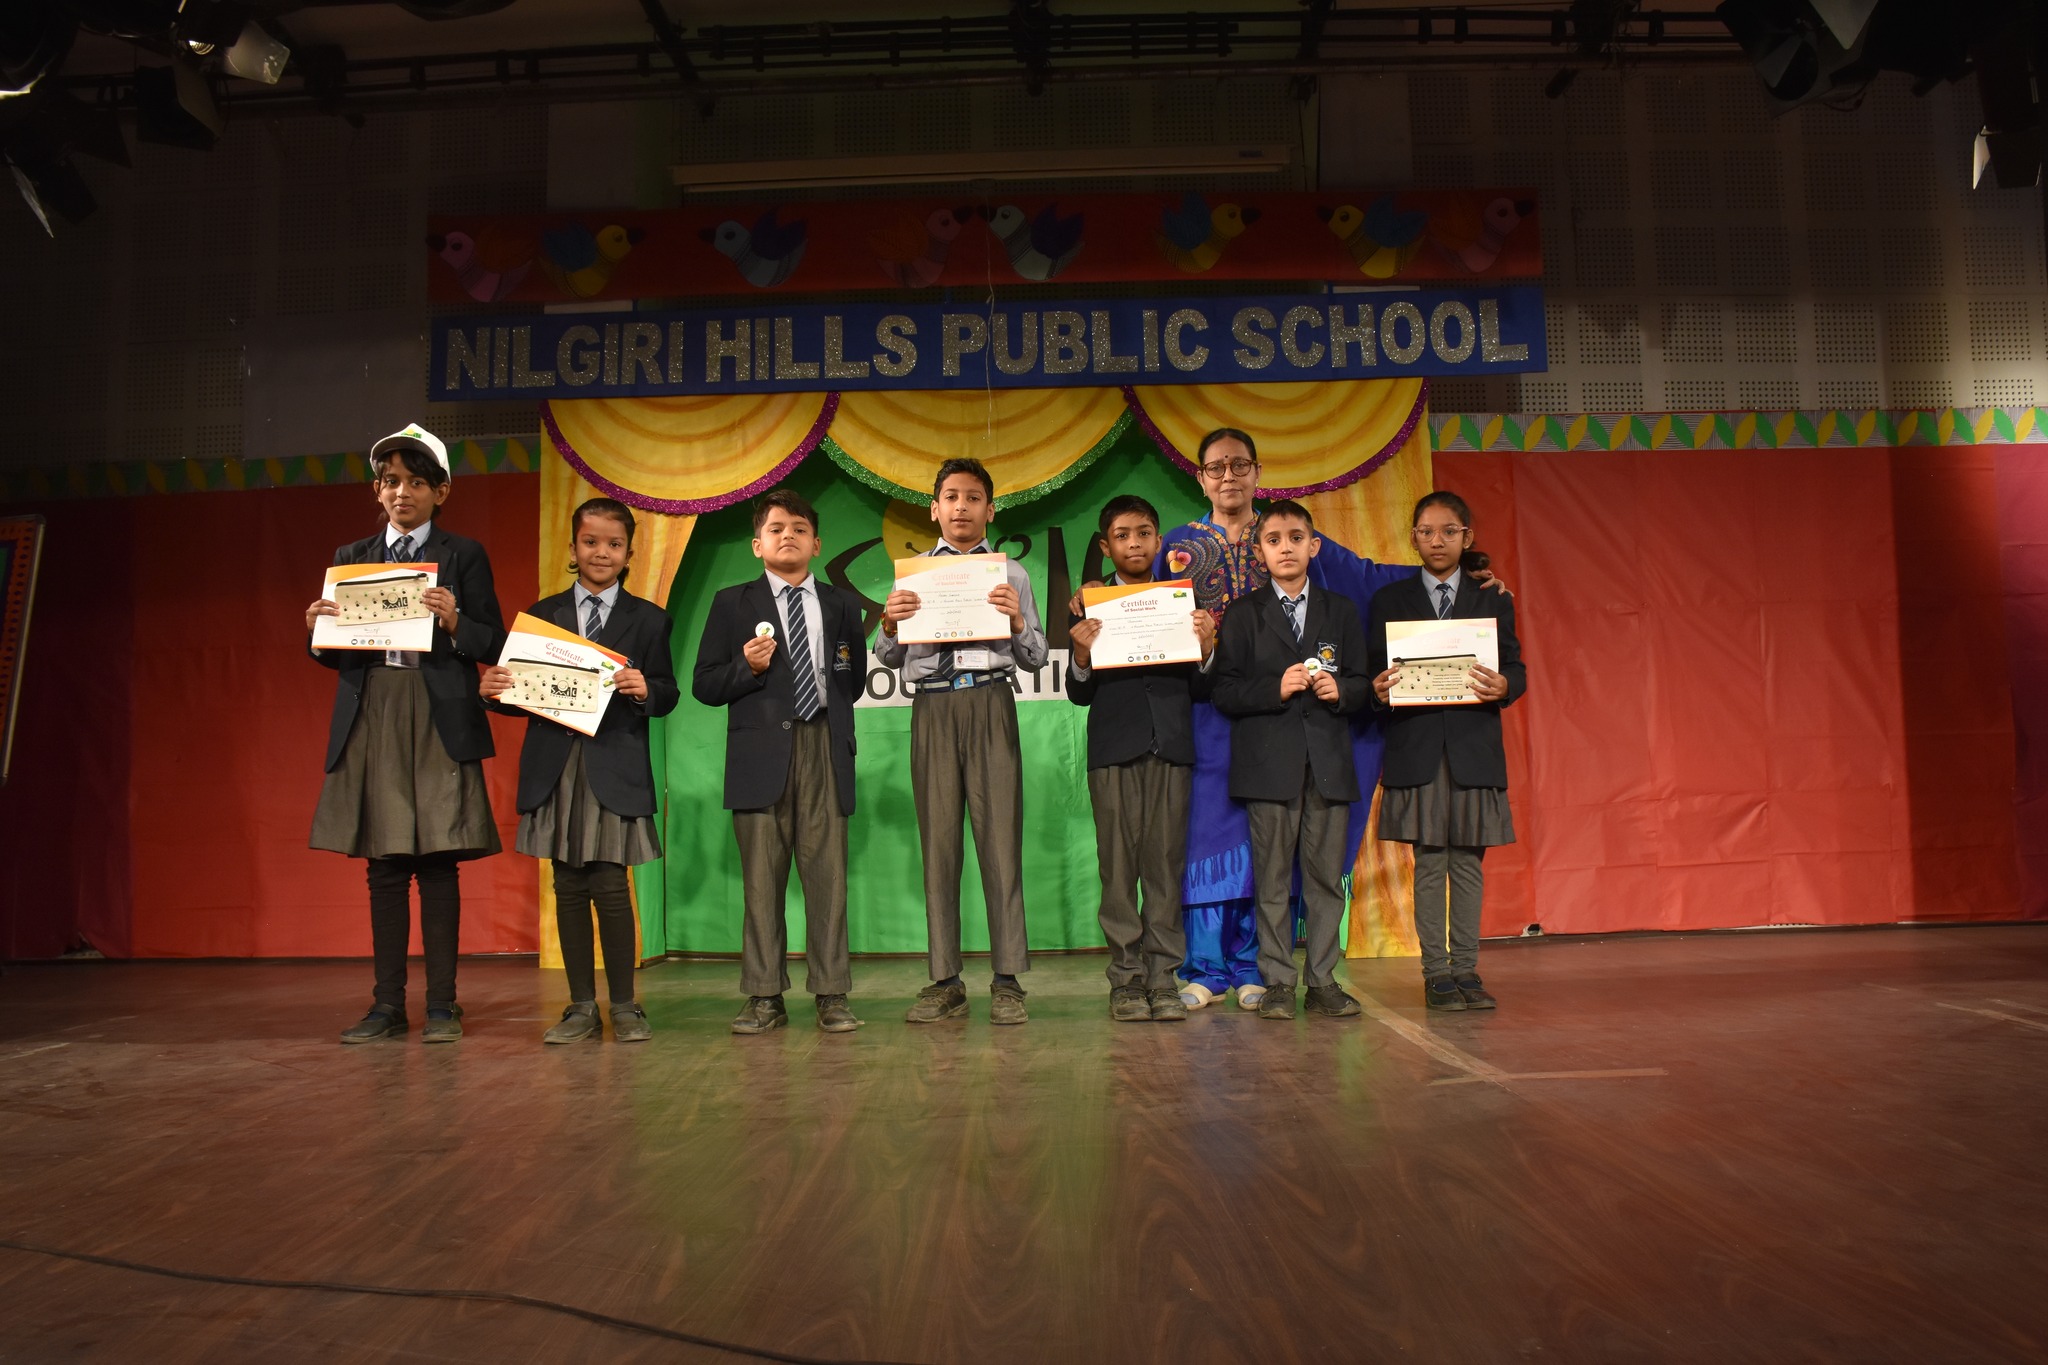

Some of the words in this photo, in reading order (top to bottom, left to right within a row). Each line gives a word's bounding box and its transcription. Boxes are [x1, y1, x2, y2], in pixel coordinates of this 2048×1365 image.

[445, 320, 684, 391] NILGIRI
[705, 314, 918, 384] HILLS
[941, 308, 1210, 377] PUBLIC
[1231, 299, 1529, 369] SCHOOL
[1120, 599, 1158, 608] Certificate
[546, 643, 585, 663] Certificate
[551, 652, 567, 662] Social
